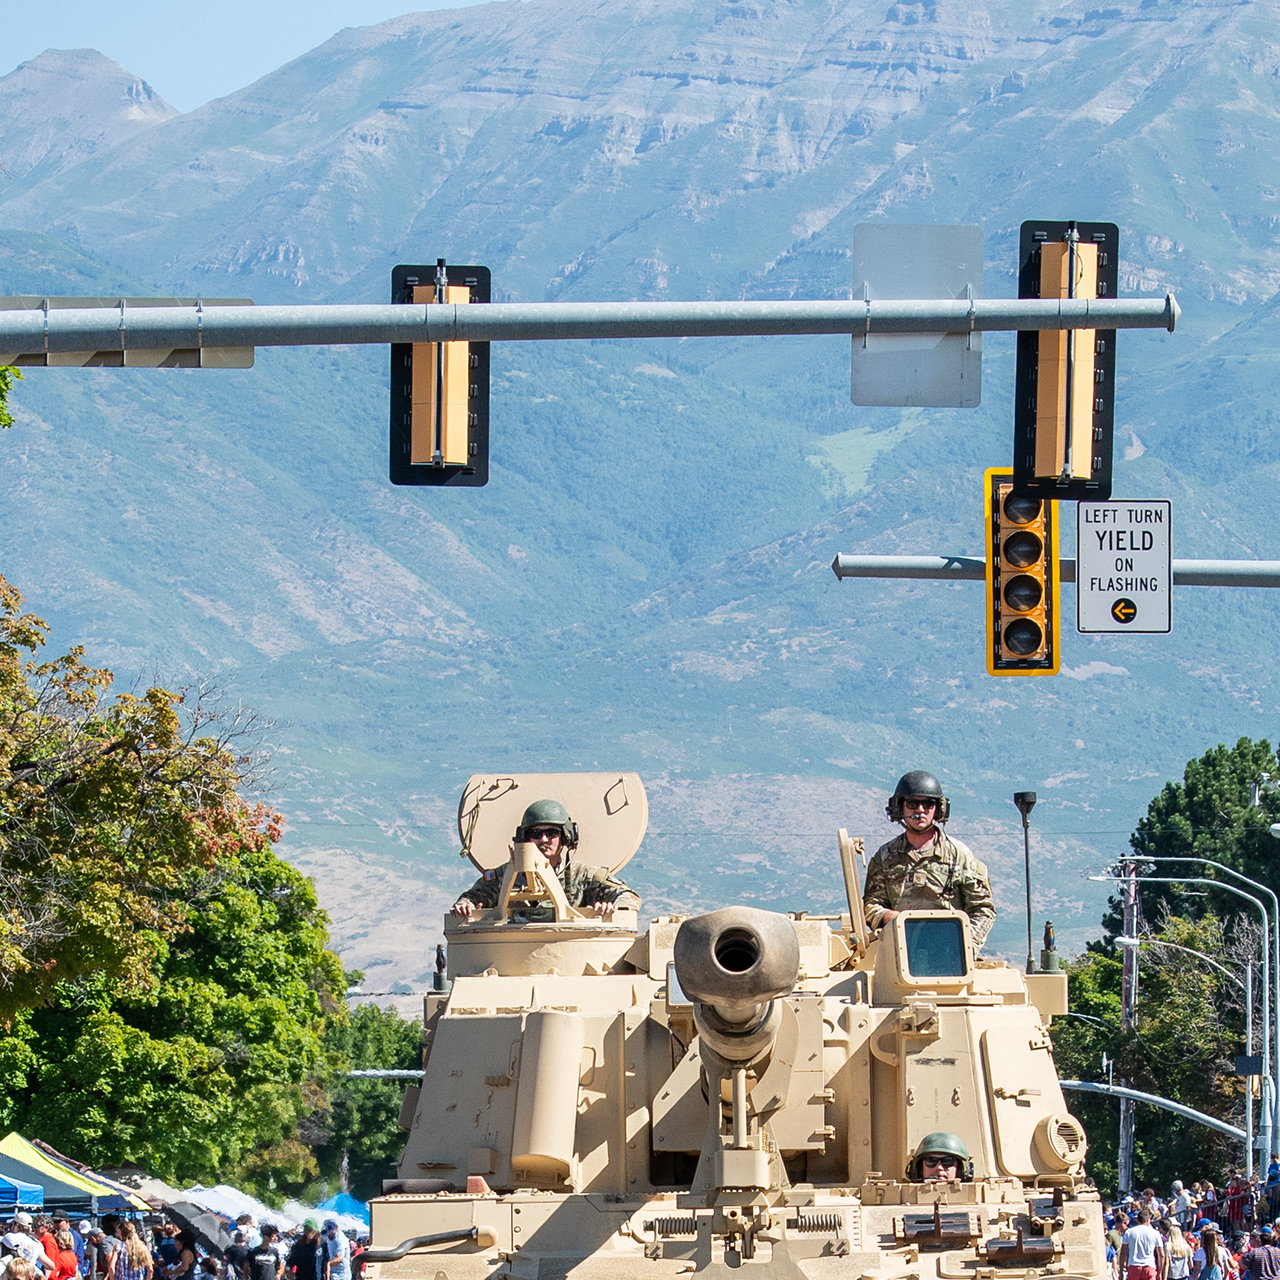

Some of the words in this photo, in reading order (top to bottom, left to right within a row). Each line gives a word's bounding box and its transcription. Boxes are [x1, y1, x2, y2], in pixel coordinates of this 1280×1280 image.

[1085, 509, 1119, 523] LEFT
[1127, 509, 1163, 523] TURN
[1095, 530, 1154, 551] YIELD
[1115, 558, 1134, 572] ON
[1090, 577, 1158, 592] FLASHING
